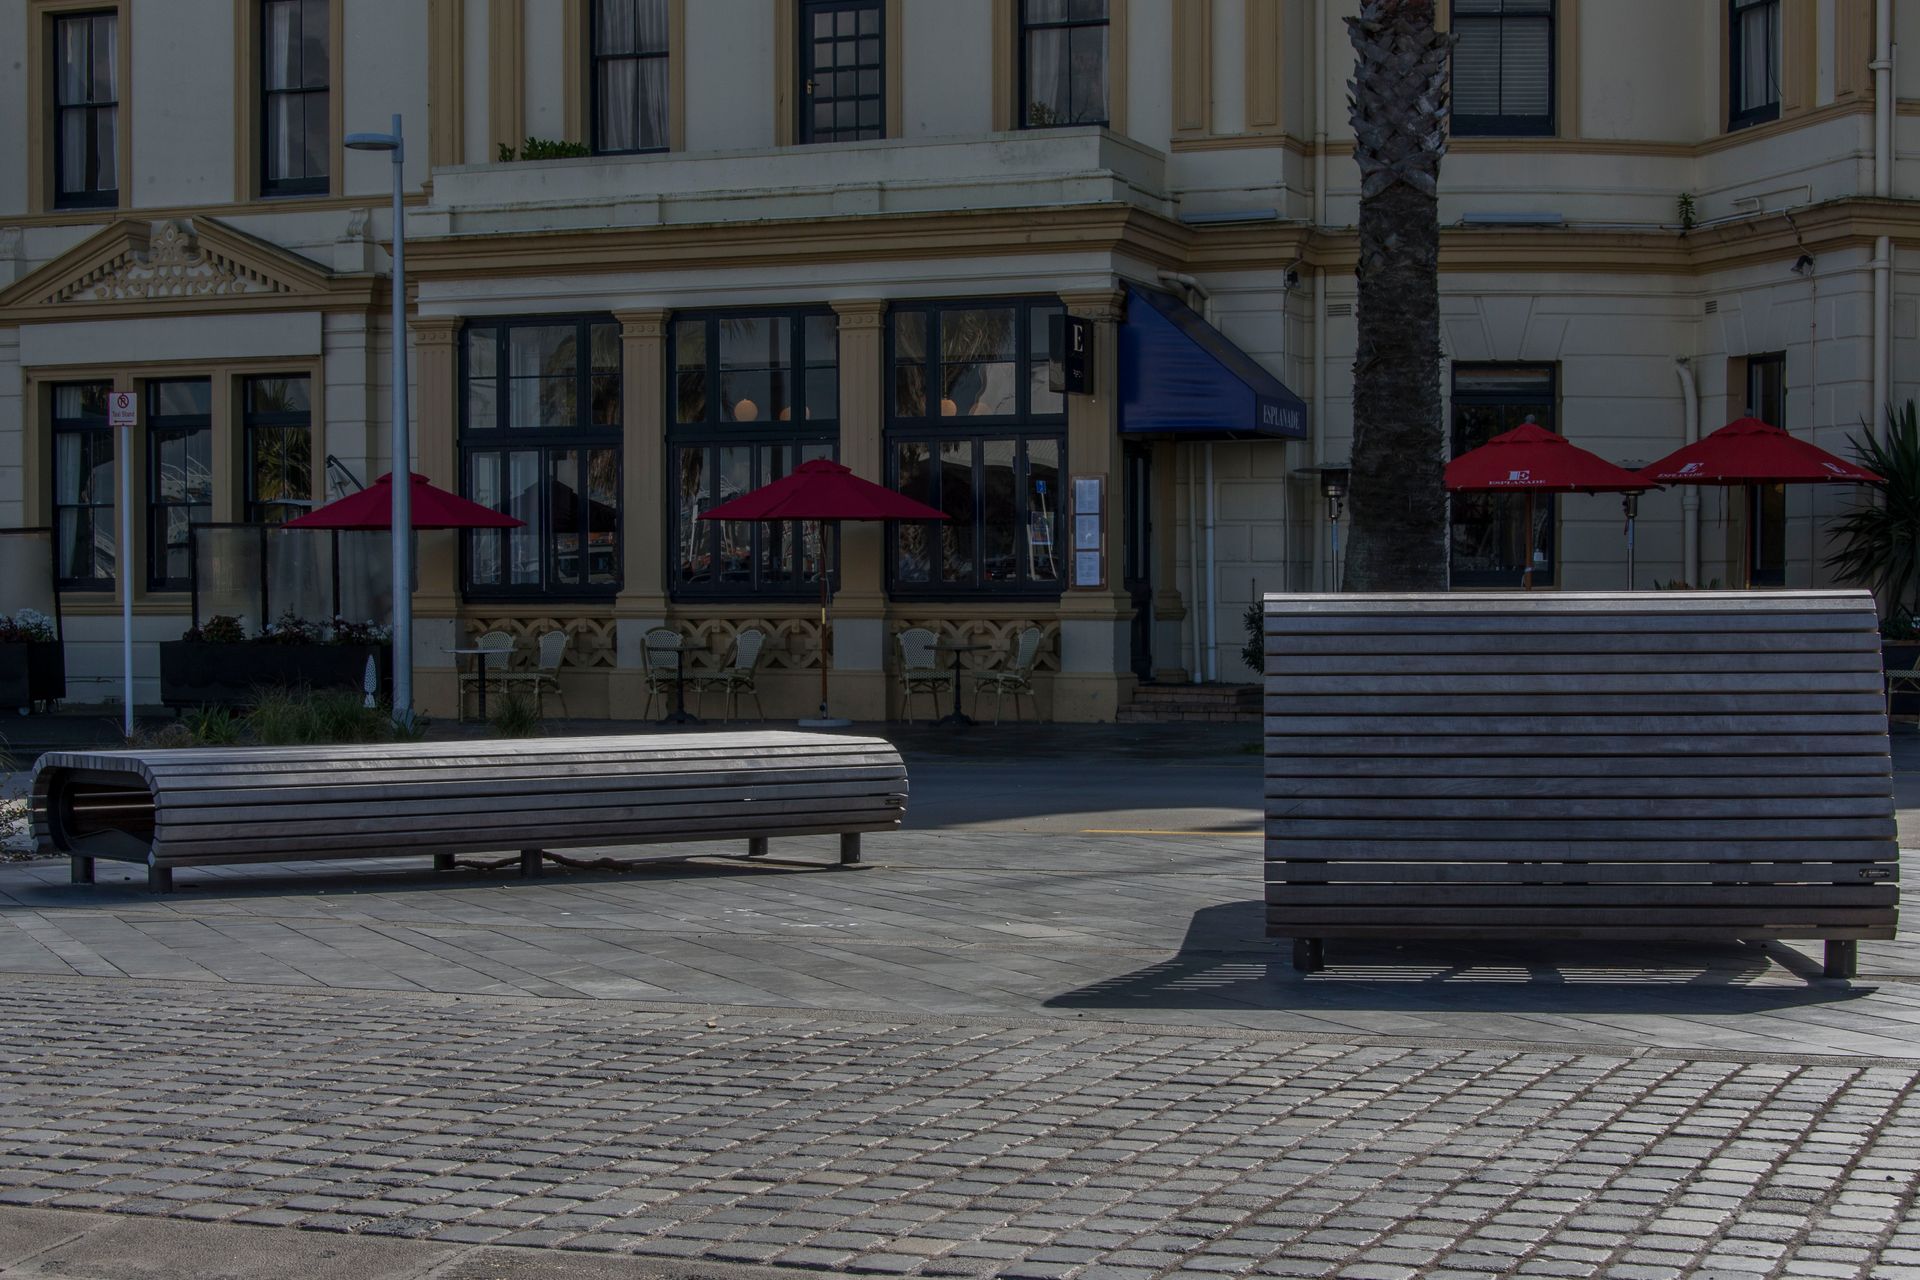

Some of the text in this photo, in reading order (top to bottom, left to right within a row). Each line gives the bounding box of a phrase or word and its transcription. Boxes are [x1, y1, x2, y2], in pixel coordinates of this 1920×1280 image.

[1073, 324, 1083, 352] E
[1263, 404, 1300, 430] ESPLANADE
[1508, 470, 1530, 481] E
